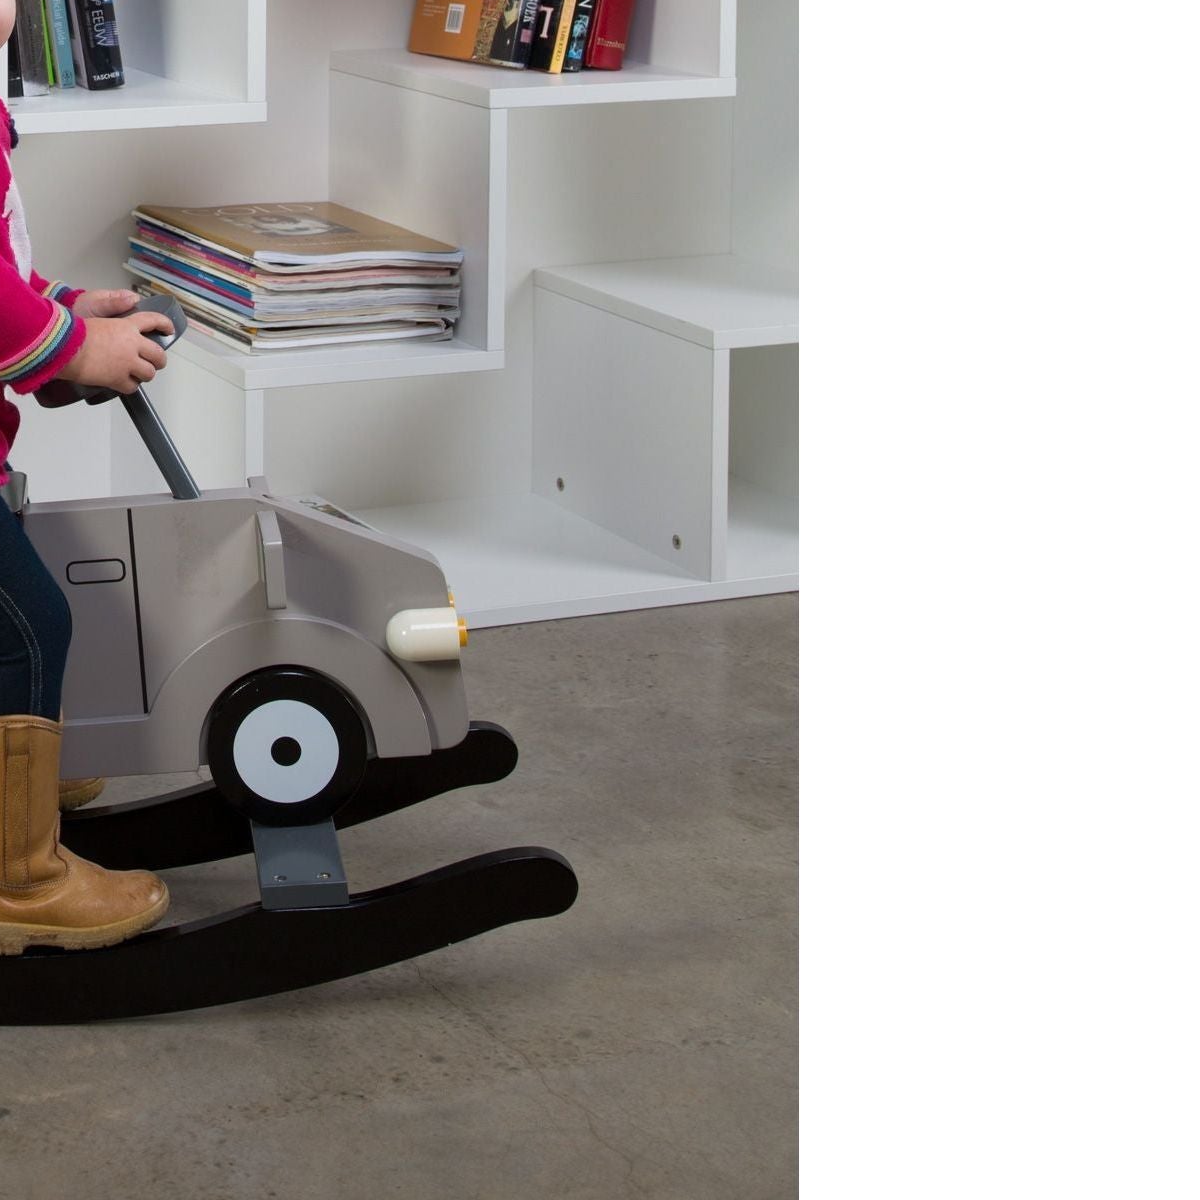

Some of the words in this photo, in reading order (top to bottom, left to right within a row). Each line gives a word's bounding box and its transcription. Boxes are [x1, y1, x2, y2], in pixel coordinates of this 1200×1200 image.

[55, 22, 65, 46] guide
[91, 9, 108, 46] EEUW
[92, 70, 121, 82] TASCHEN
